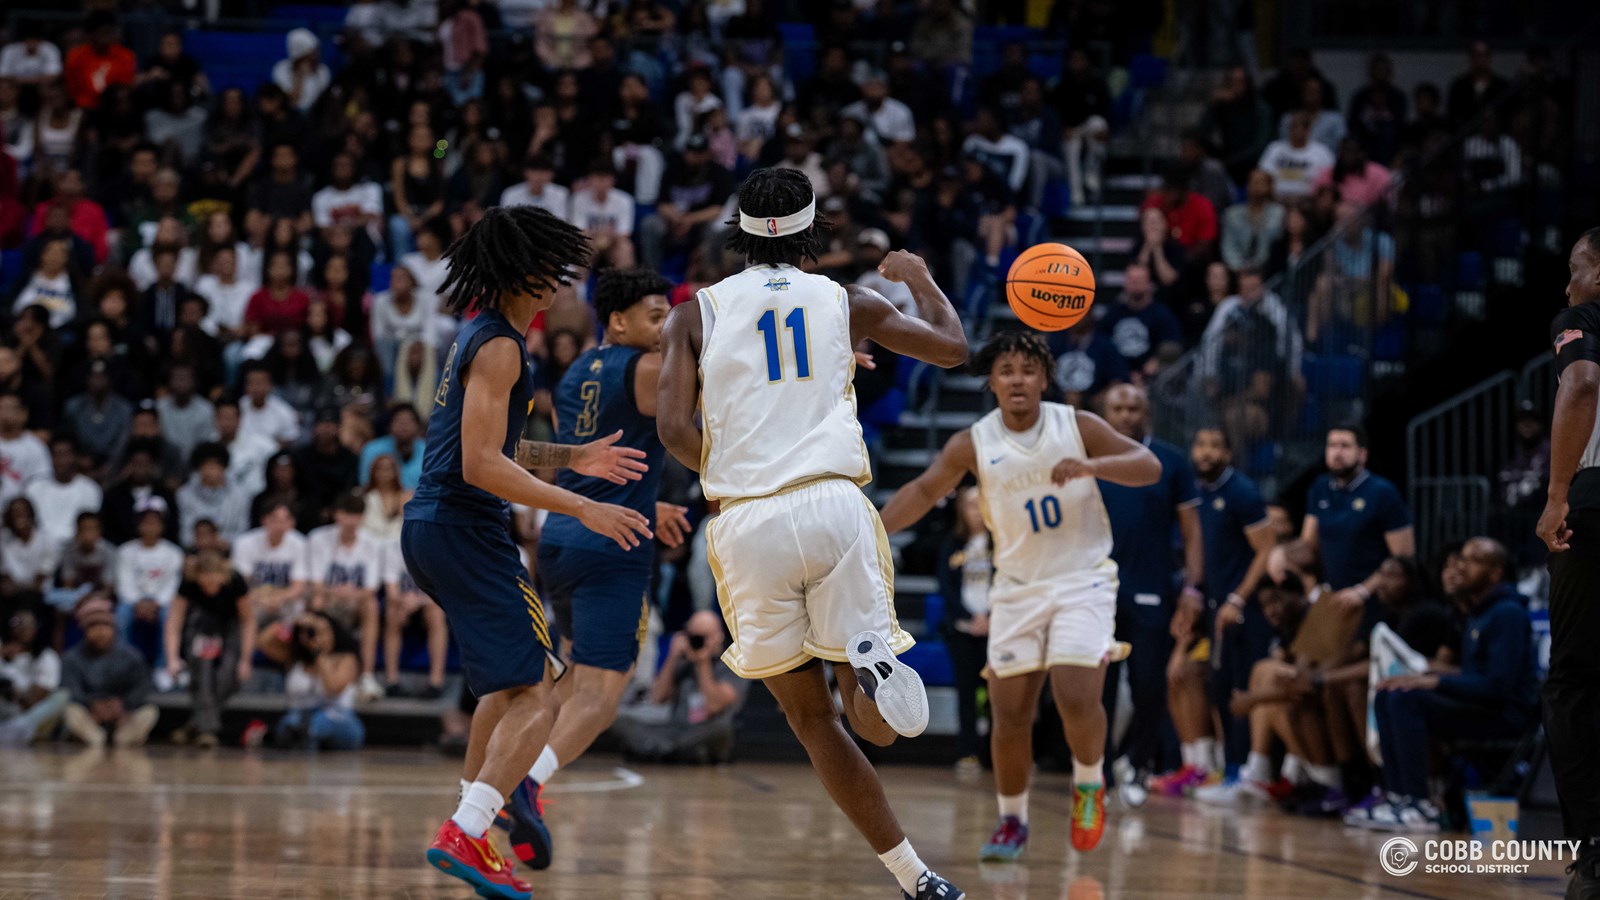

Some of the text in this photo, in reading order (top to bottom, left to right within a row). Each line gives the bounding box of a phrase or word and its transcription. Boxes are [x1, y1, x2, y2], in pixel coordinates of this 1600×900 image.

[1031, 288, 1086, 309] Wilson
[755, 305, 814, 385] 11
[575, 381, 601, 437] 3
[1024, 494, 1063, 533] 10
